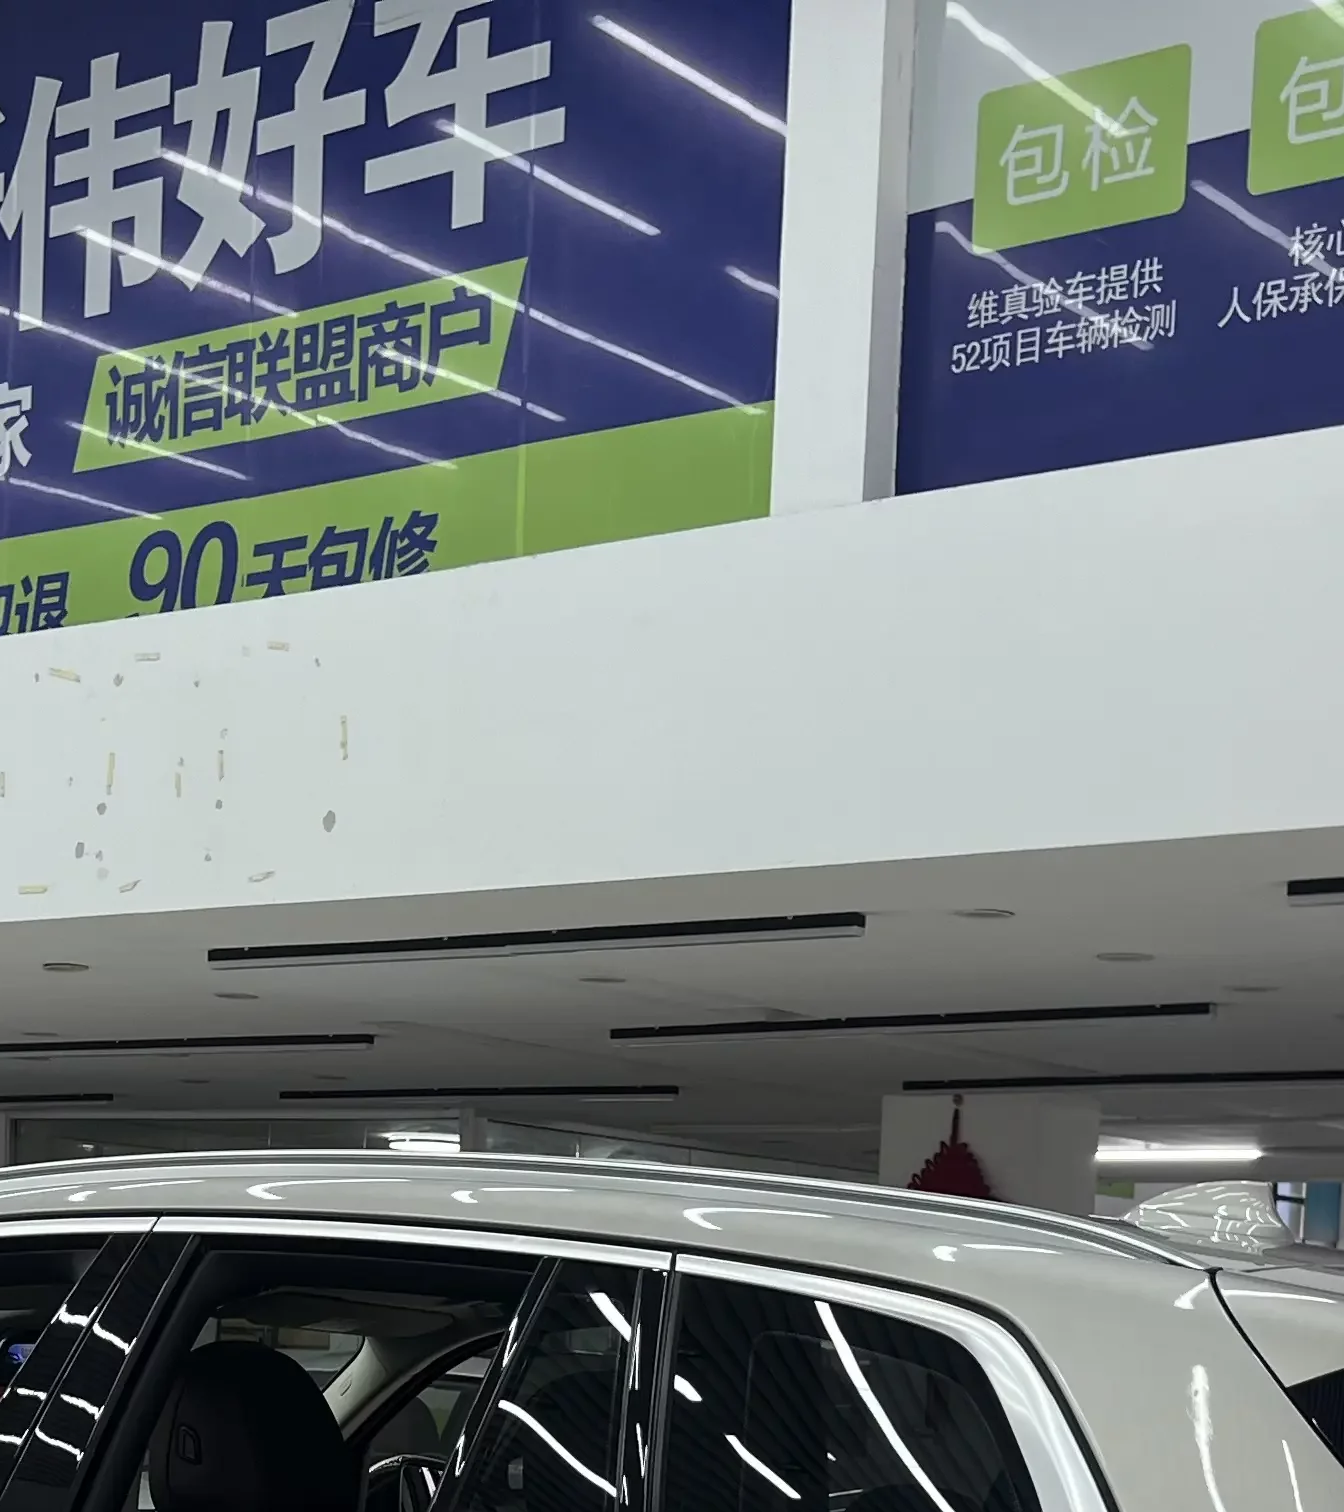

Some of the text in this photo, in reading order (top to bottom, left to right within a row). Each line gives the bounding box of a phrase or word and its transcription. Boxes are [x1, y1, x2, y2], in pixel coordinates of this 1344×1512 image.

[999, 97, 1158, 207] 包检
[950, 302, 1177, 375] 52项目车辆检测
[966, 259, 1164, 330] 维真验车提供
[105, 287, 493, 447] 诚信联盟商户
[129, 510, 439, 618] 90天包修
